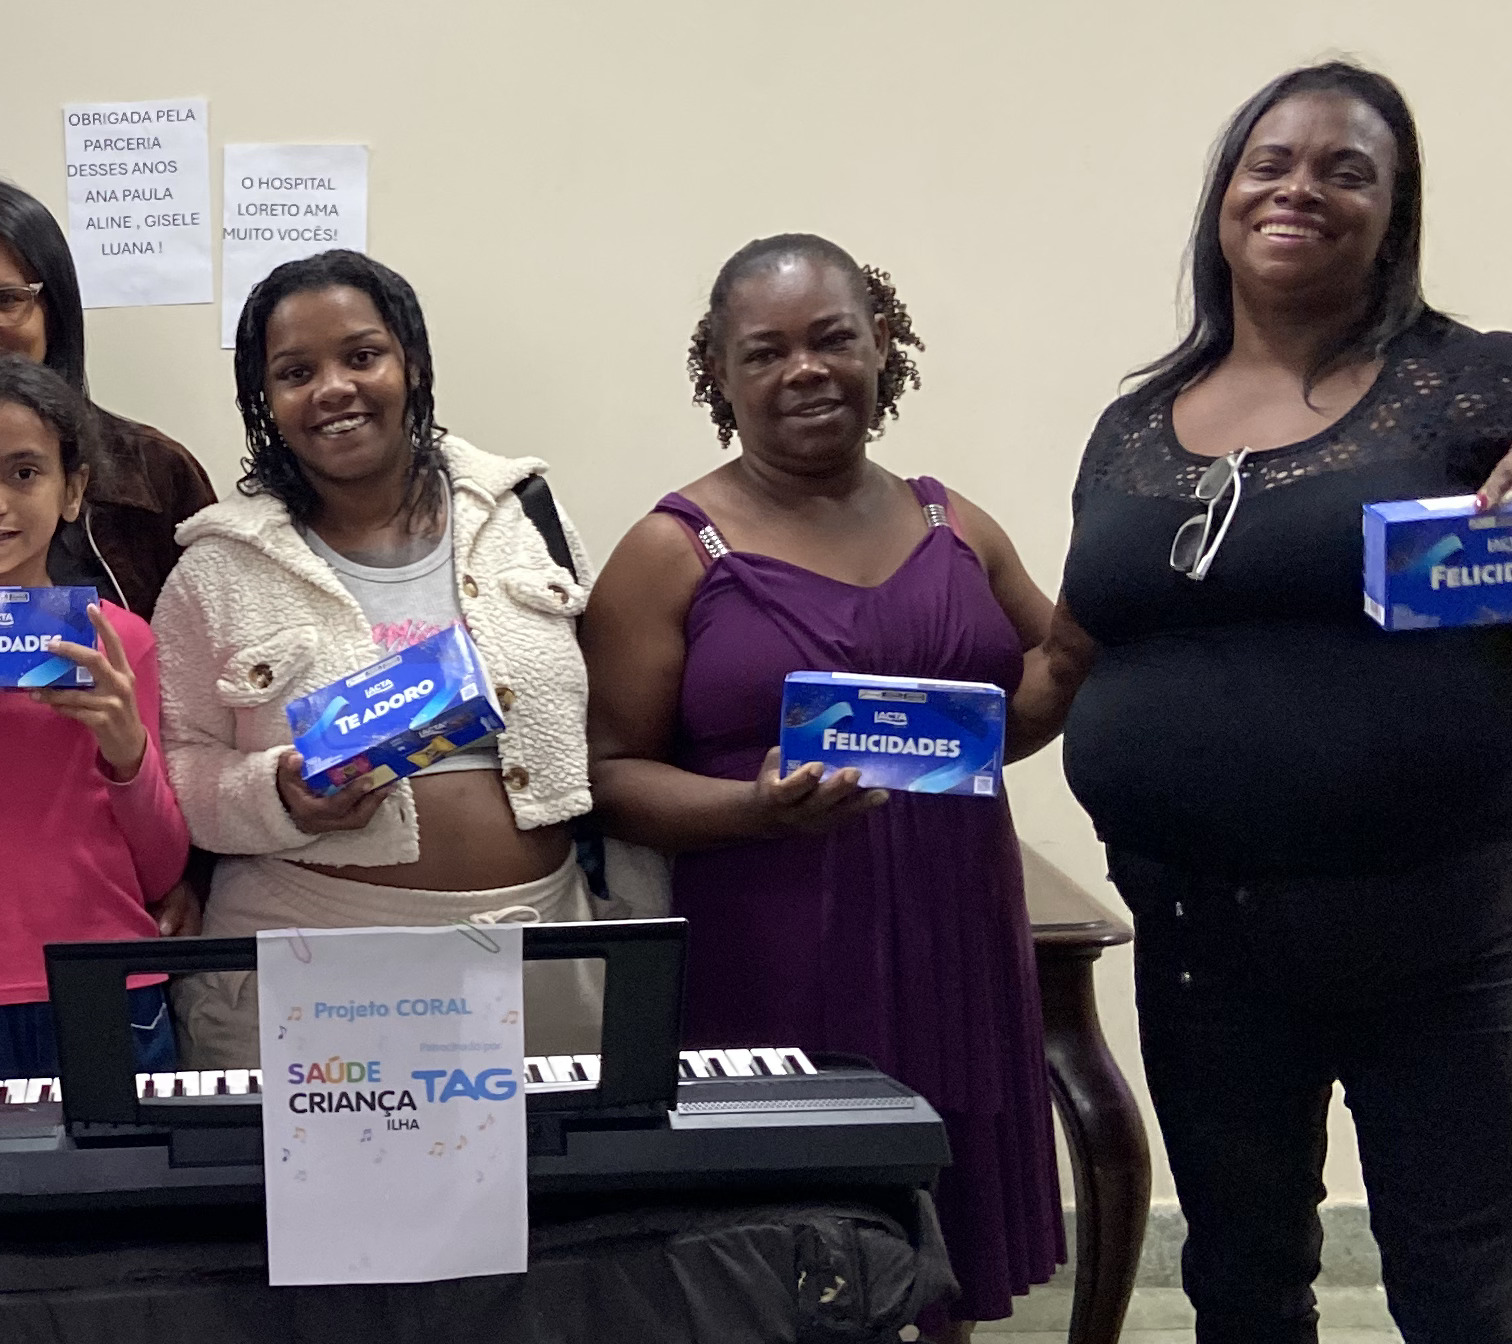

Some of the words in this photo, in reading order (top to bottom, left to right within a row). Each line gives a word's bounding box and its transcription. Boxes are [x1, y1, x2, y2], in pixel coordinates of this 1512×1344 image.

[68, 111, 152, 127] OBRIGADA
[156, 109, 196, 123] PELA
[84, 137, 162, 152] PARCERIA
[67, 163, 128, 177] DESSES
[131, 160, 178, 175] ANOS
[241, 177, 254, 190] O
[258, 177, 336, 191] HOSPITAL
[85, 190, 117, 203] ANA
[122, 188, 173, 202] PAULA
[238, 203, 300, 217] LORETO
[303, 204, 339, 217] AMA
[144, 212, 201, 228] GISELE
[222, 227, 274, 241] MUITO
[277, 226, 339, 242] VOCÊS!
[335, 713, 361, 735] TE
[362, 679, 434, 724] ADORO
[822, 728, 961, 758] FELICIDADES
[314, 1000, 389, 1022] Projeto
[396, 998, 473, 1017] CORAL
[288, 1056, 381, 1085] SAÚDE
[411, 1068, 517, 1103] TAG
[289, 1090, 418, 1117] CRIANÇA
[387, 1119, 420, 1131] ILHA
